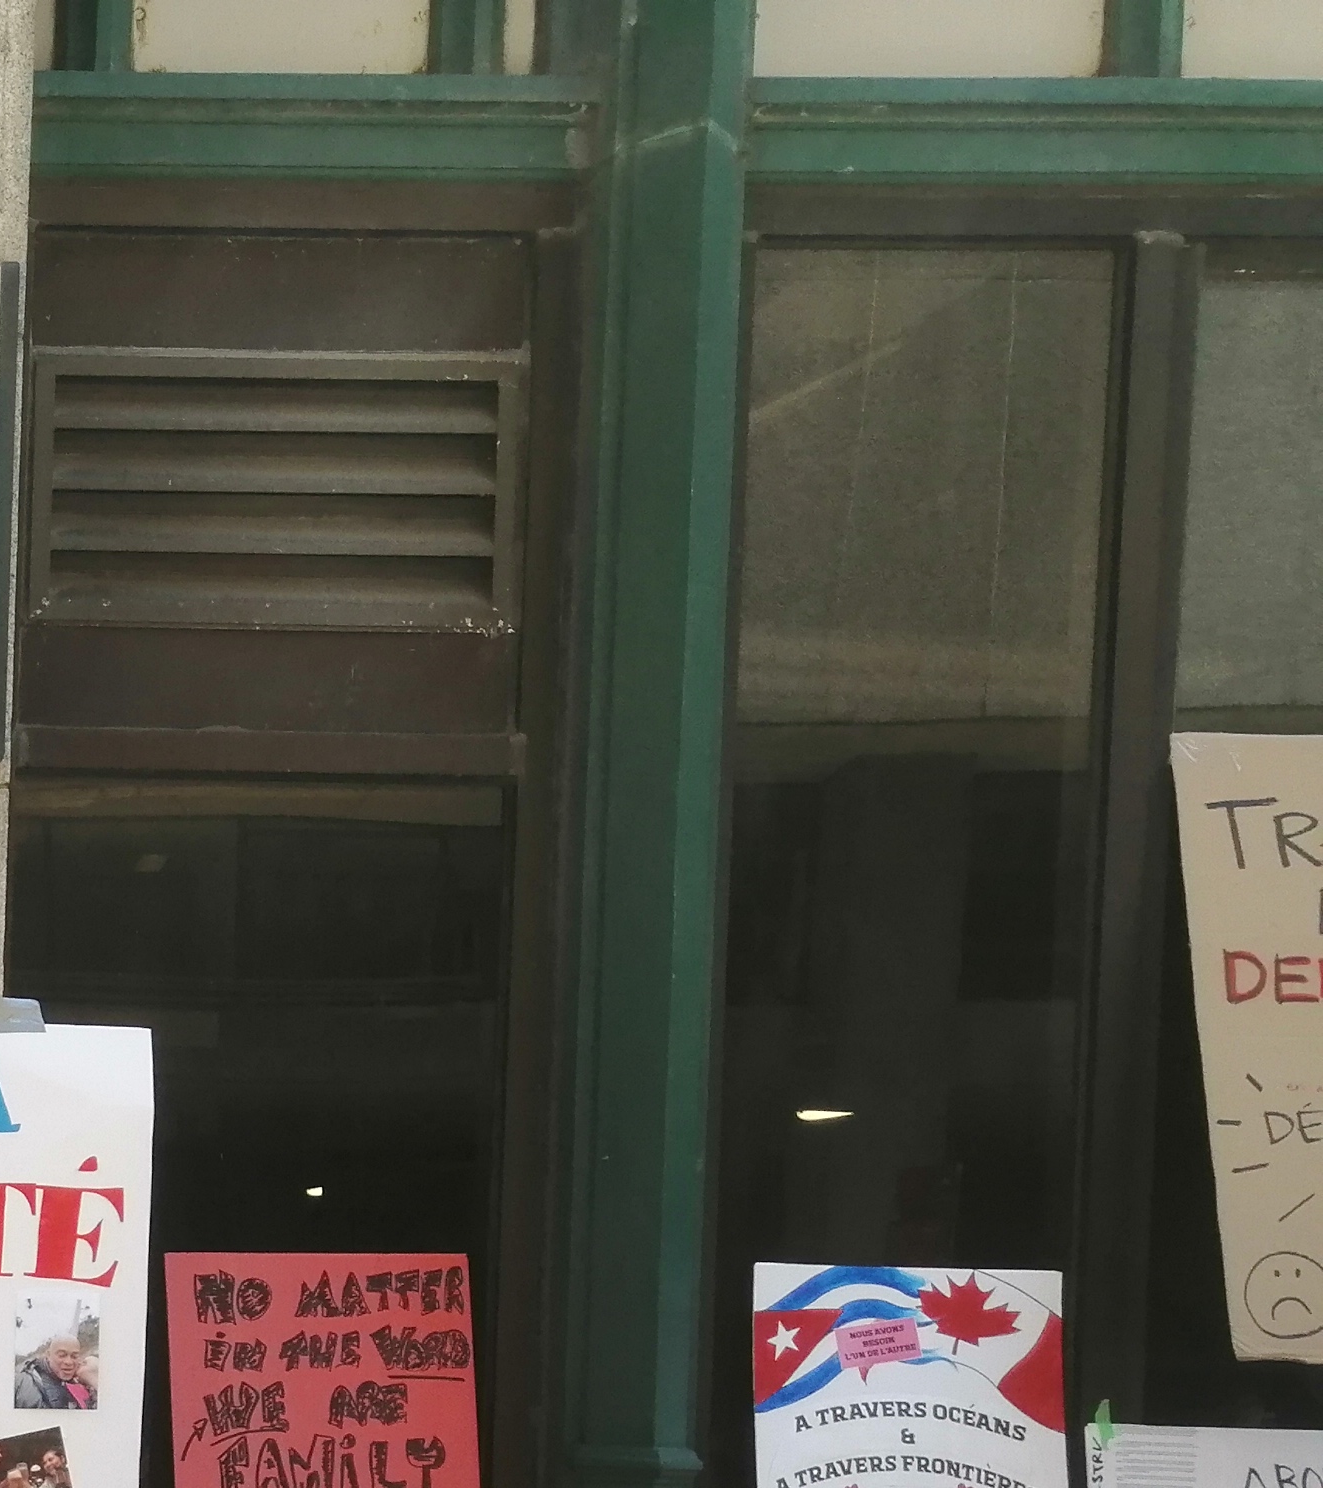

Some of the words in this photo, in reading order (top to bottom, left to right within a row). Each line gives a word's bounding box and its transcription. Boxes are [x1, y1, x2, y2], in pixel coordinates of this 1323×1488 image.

[1205, 797, 1323, 869] TR
[1223, 949, 1323, 1004] DE
[194, 1270, 272, 1325] NO
[294, 1265, 466, 1317] MATTER
[280, 1330, 360, 1370] THE
[849, 1330, 873, 1339] NOUS
[875, 1325, 904, 1334] AVONS
[862, 1337, 895, 1347] BESOIN
[867, 1349, 879, 1357] DE
[881, 1344, 916, 1355] L'AUTRE
[204, 1381, 289, 1434] WE
[330, 1381, 407, 1426] ARE
[795, 1415, 812, 1433] A
[815, 1401, 927, 1426] TRAVERS
[933, 1404, 1027, 1442] OCÉANS
[901, 1428, 916, 1445] &
[794, 1455, 897, 1488] TRAVERS
